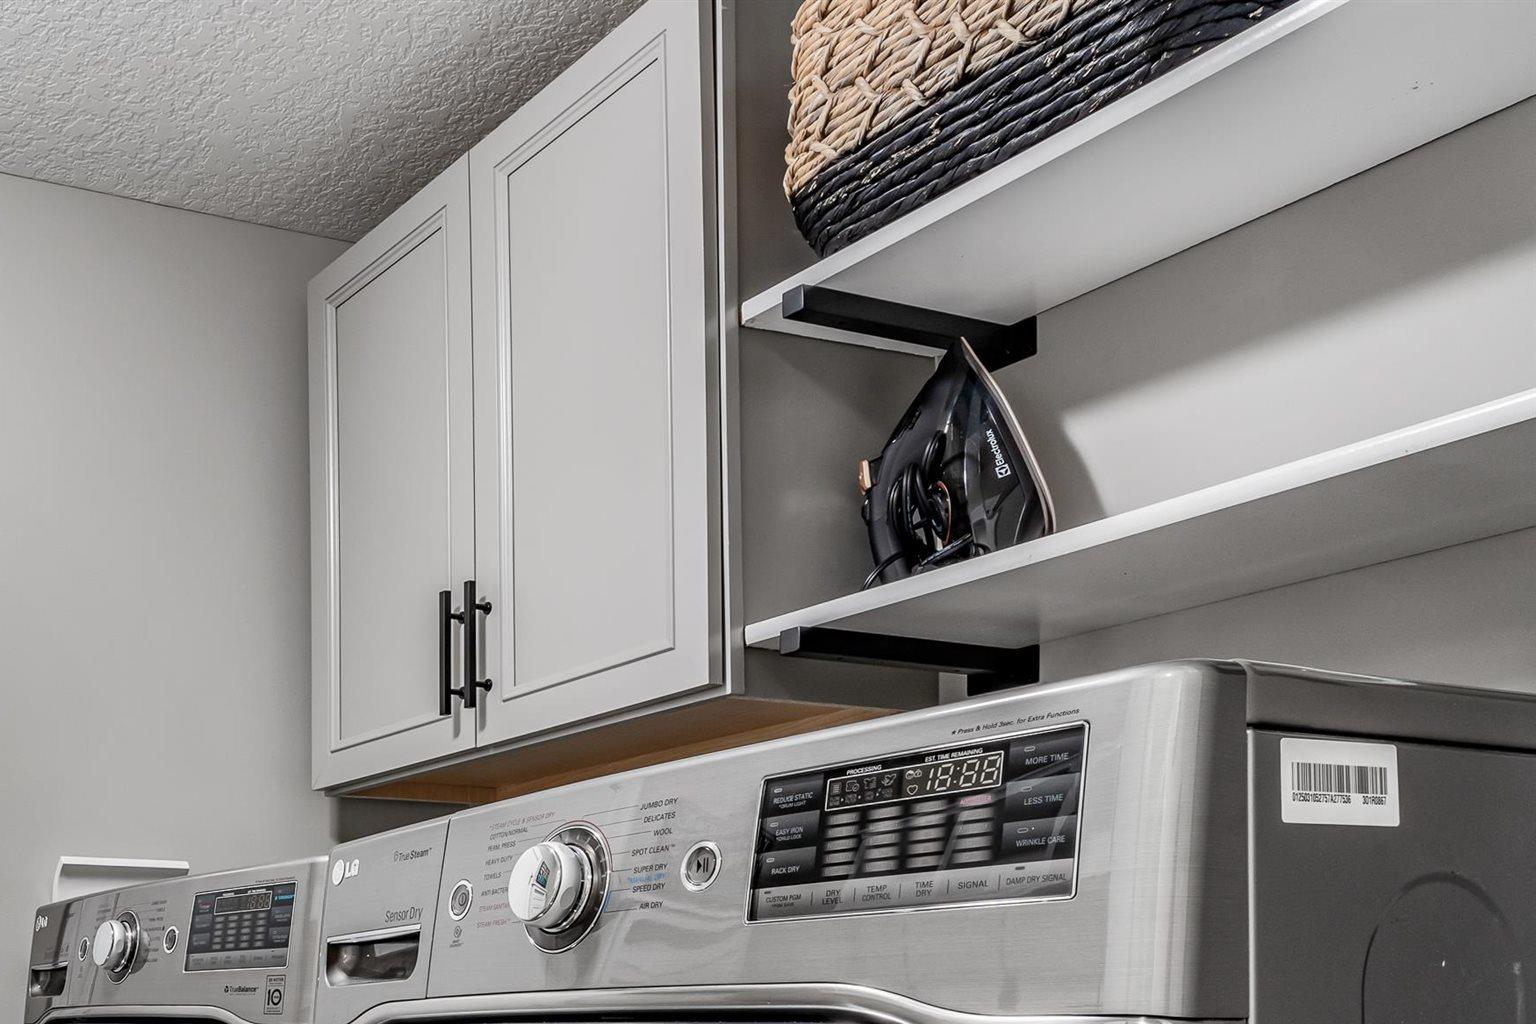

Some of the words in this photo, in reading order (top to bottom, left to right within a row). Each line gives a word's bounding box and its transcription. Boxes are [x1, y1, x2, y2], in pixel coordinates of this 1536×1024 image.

[986, 429, 1005, 466] Electrolux
[1017, 717, 1025, 725] for
[1028, 714, 1045, 723] Extra
[1046, 708, 1080, 719] Functions
[938, 752, 950, 761] TIME
[951, 747, 983, 759] REMAINING
[1025, 755, 1048, 765] MORE
[1051, 752, 1069, 761] TIME
[846, 764, 882, 775] PROCESSING
[795, 792, 814, 802] STATIC
[1024, 796, 1043, 806] LESS
[1045, 793, 1064, 802] TIME
[640, 800, 664, 811] JUMBO
[664, 797, 679, 806] DRY
[643, 811, 676, 823] DELICATES
[653, 828, 673, 836] WOOL
[1015, 837, 1046, 847] WRINKLE
[1047, 835, 1066, 844] CARE
[631, 848, 648, 857] SPOT
[633, 864, 653, 874] SUPER
[654, 863, 668, 872] DRY
[771, 867, 786, 876] RACK
[915, 881, 933, 889] TIME
[957, 880, 989, 890] SIGNAL
[1006, 877, 1026, 886] DAMP
[1026, 875, 1040, 883] DRY
[1042, 873, 1067, 882] SIGNAL
[632, 884, 652, 893] SPEED
[652, 882, 665, 891] DRY
[826, 889, 841, 897] DRY
[867, 885, 887, 893] TEMP
[916, 889, 932, 897] DRY
[822, 897, 842, 905] LEVEL
[862, 893, 891, 902] CONTROL
[639, 902, 651, 910] AIR
[651, 901, 664, 909] DRY
[384, 910, 409, 923] Sensor
[409, 906, 424, 920] Dry
[267, 988, 282, 1006] 10
